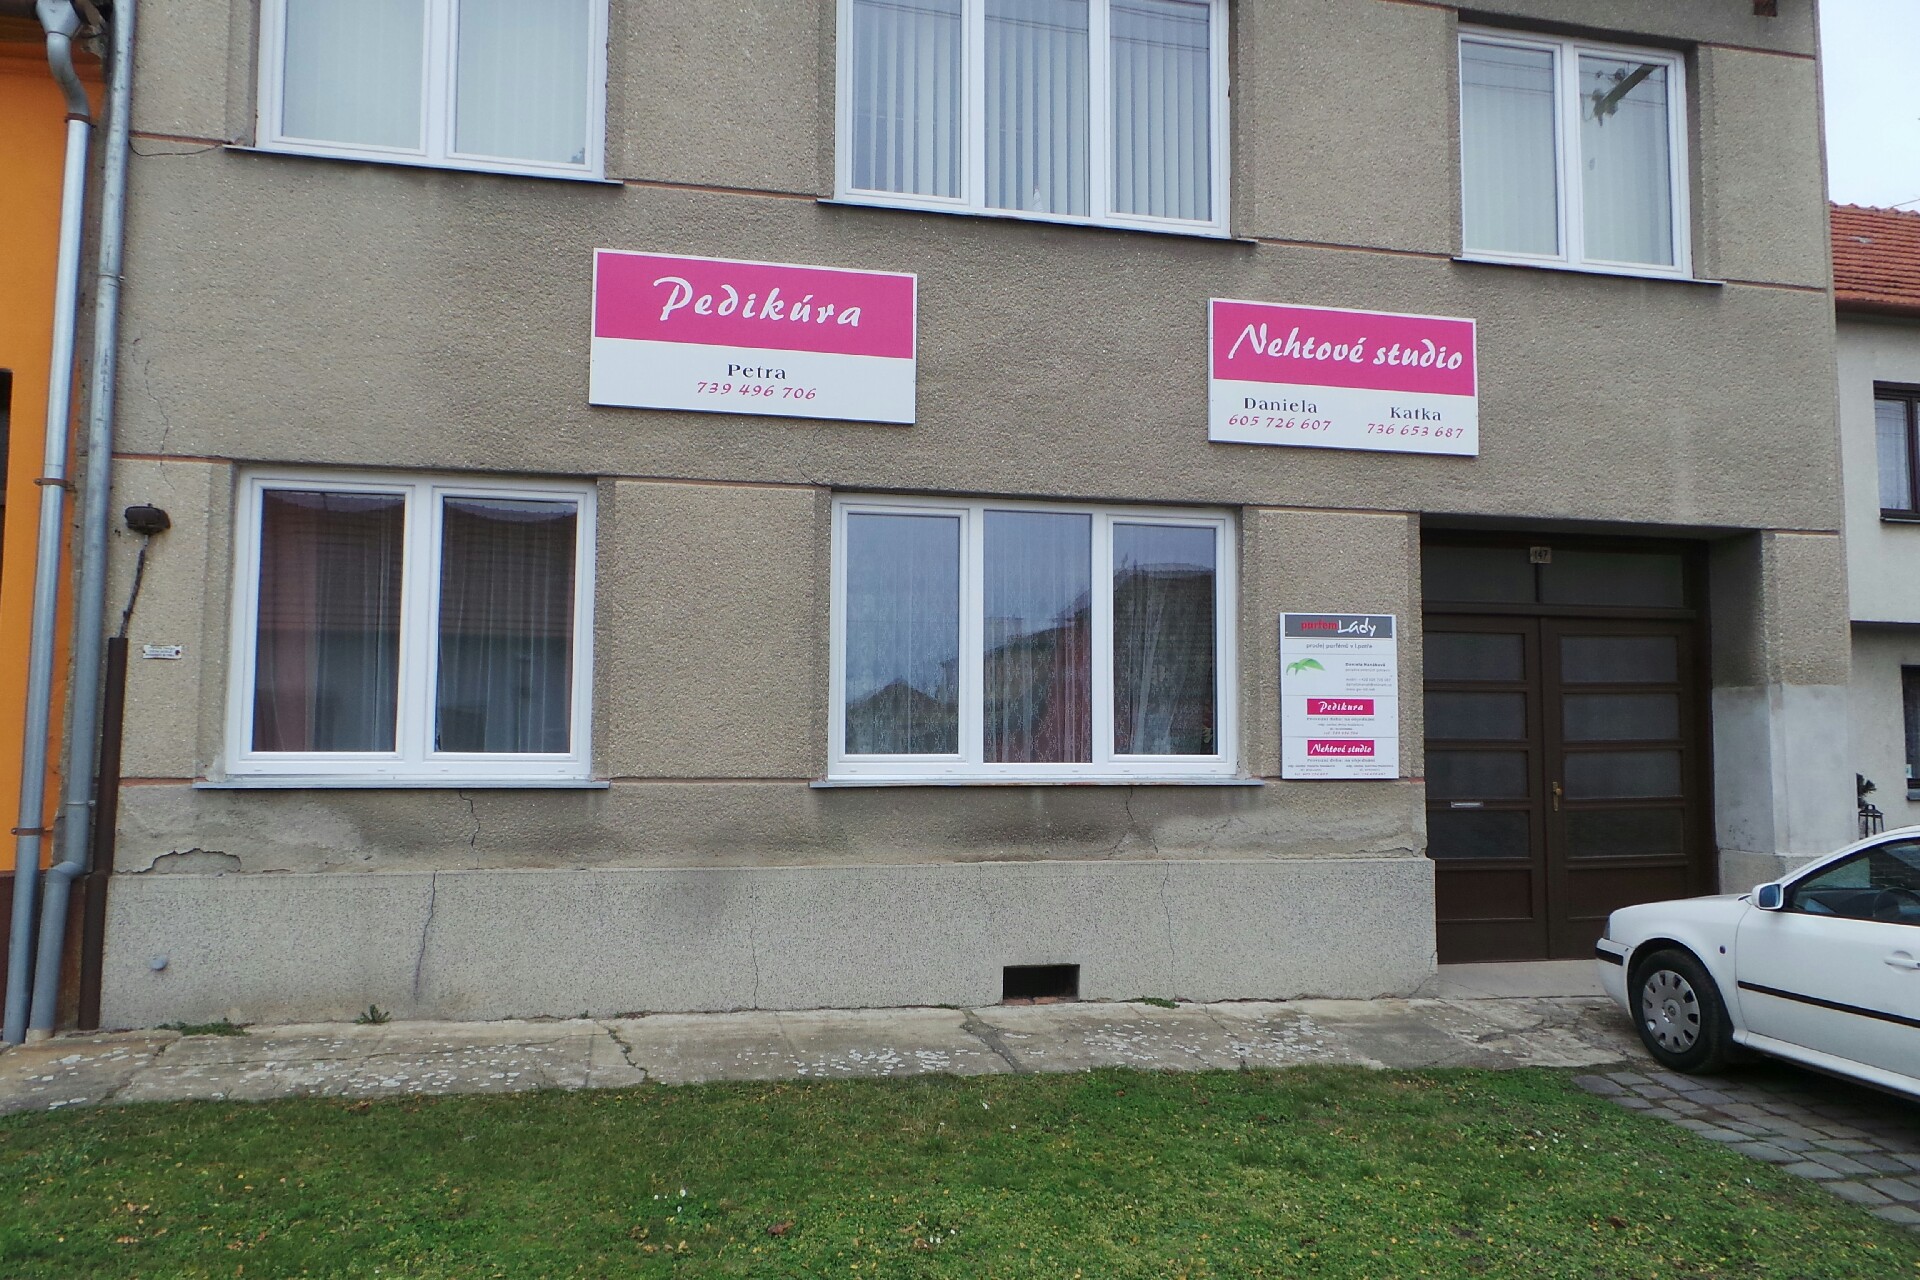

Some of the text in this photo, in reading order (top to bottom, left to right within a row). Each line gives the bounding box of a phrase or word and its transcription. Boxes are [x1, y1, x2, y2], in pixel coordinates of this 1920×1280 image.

[653, 276, 862, 328] Pedikúra
[1228, 322, 1464, 370] Nehtové studio
[727, 363, 787, 380] Petra
[697, 381, 817, 400] 739 496 706
[1243, 396, 1318, 414] Daniela
[1389, 406, 1442, 421] Katka
[1228, 414, 1332, 432] 605 726 607
[1366, 422, 1465, 439] 736 653 687
[1310, 743, 1372, 755] Nehtové studio
